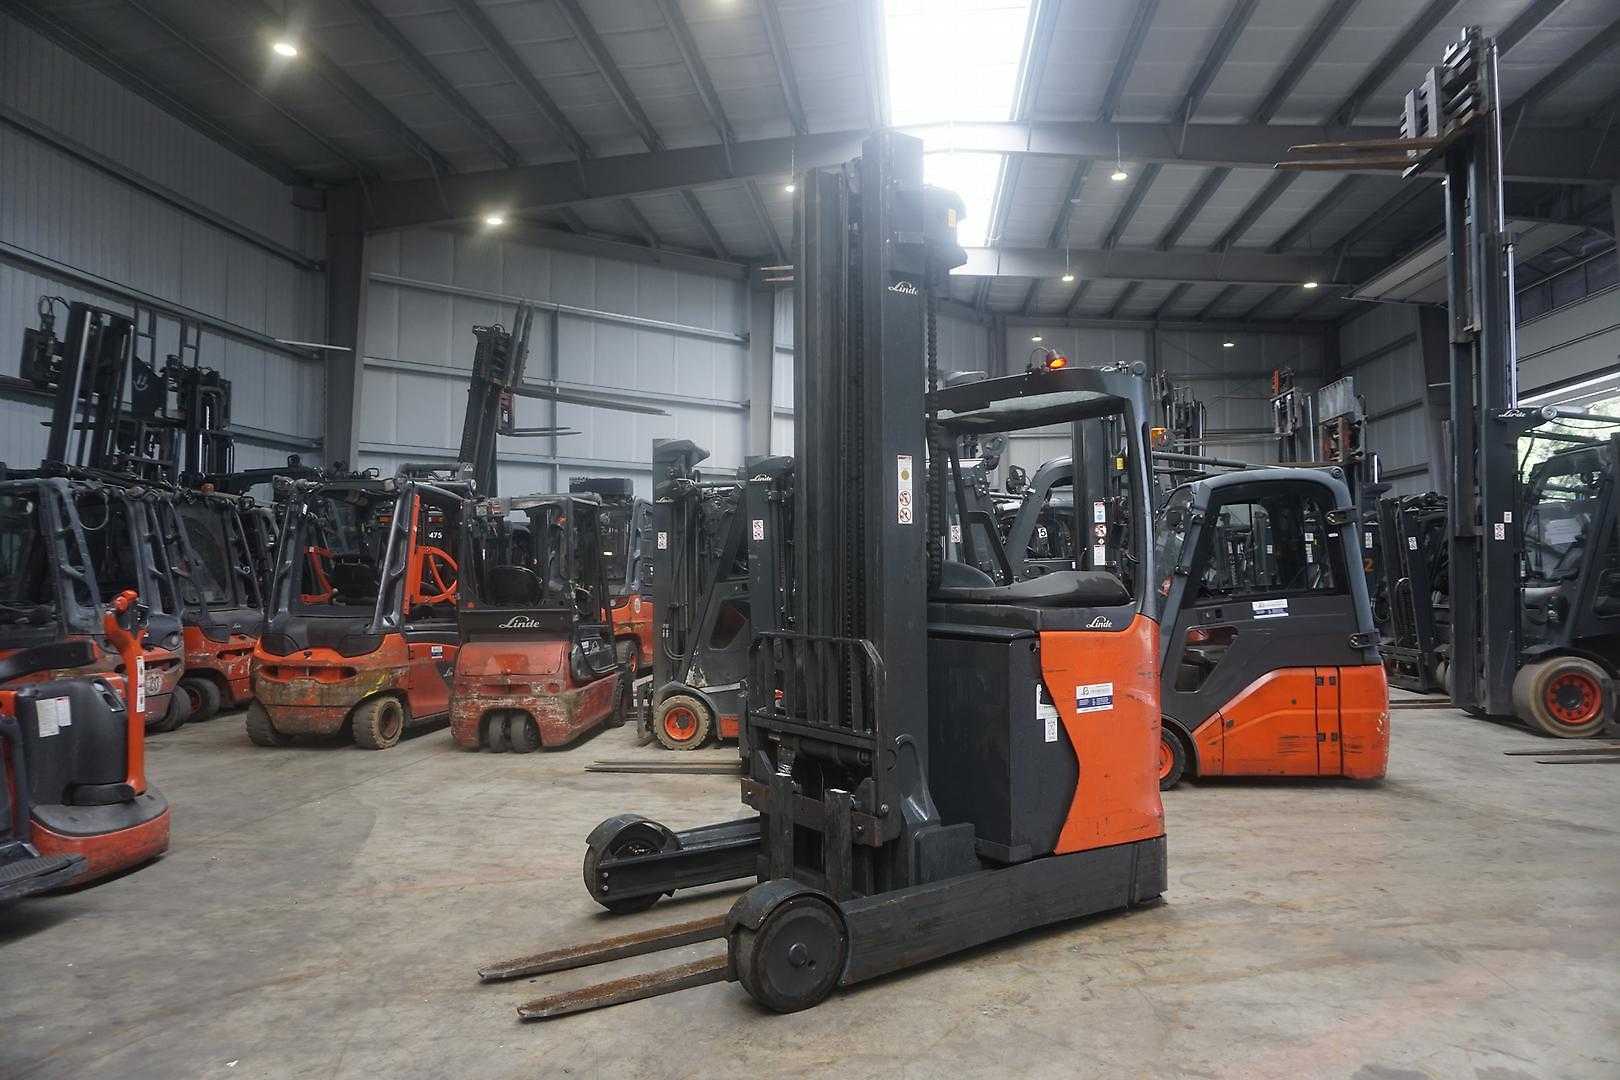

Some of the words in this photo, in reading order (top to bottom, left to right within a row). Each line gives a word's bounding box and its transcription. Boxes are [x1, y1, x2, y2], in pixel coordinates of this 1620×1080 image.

[429, 531, 442, 539] 475
[498, 615, 540, 629] Linde
[1086, 615, 1112, 628] Linde
